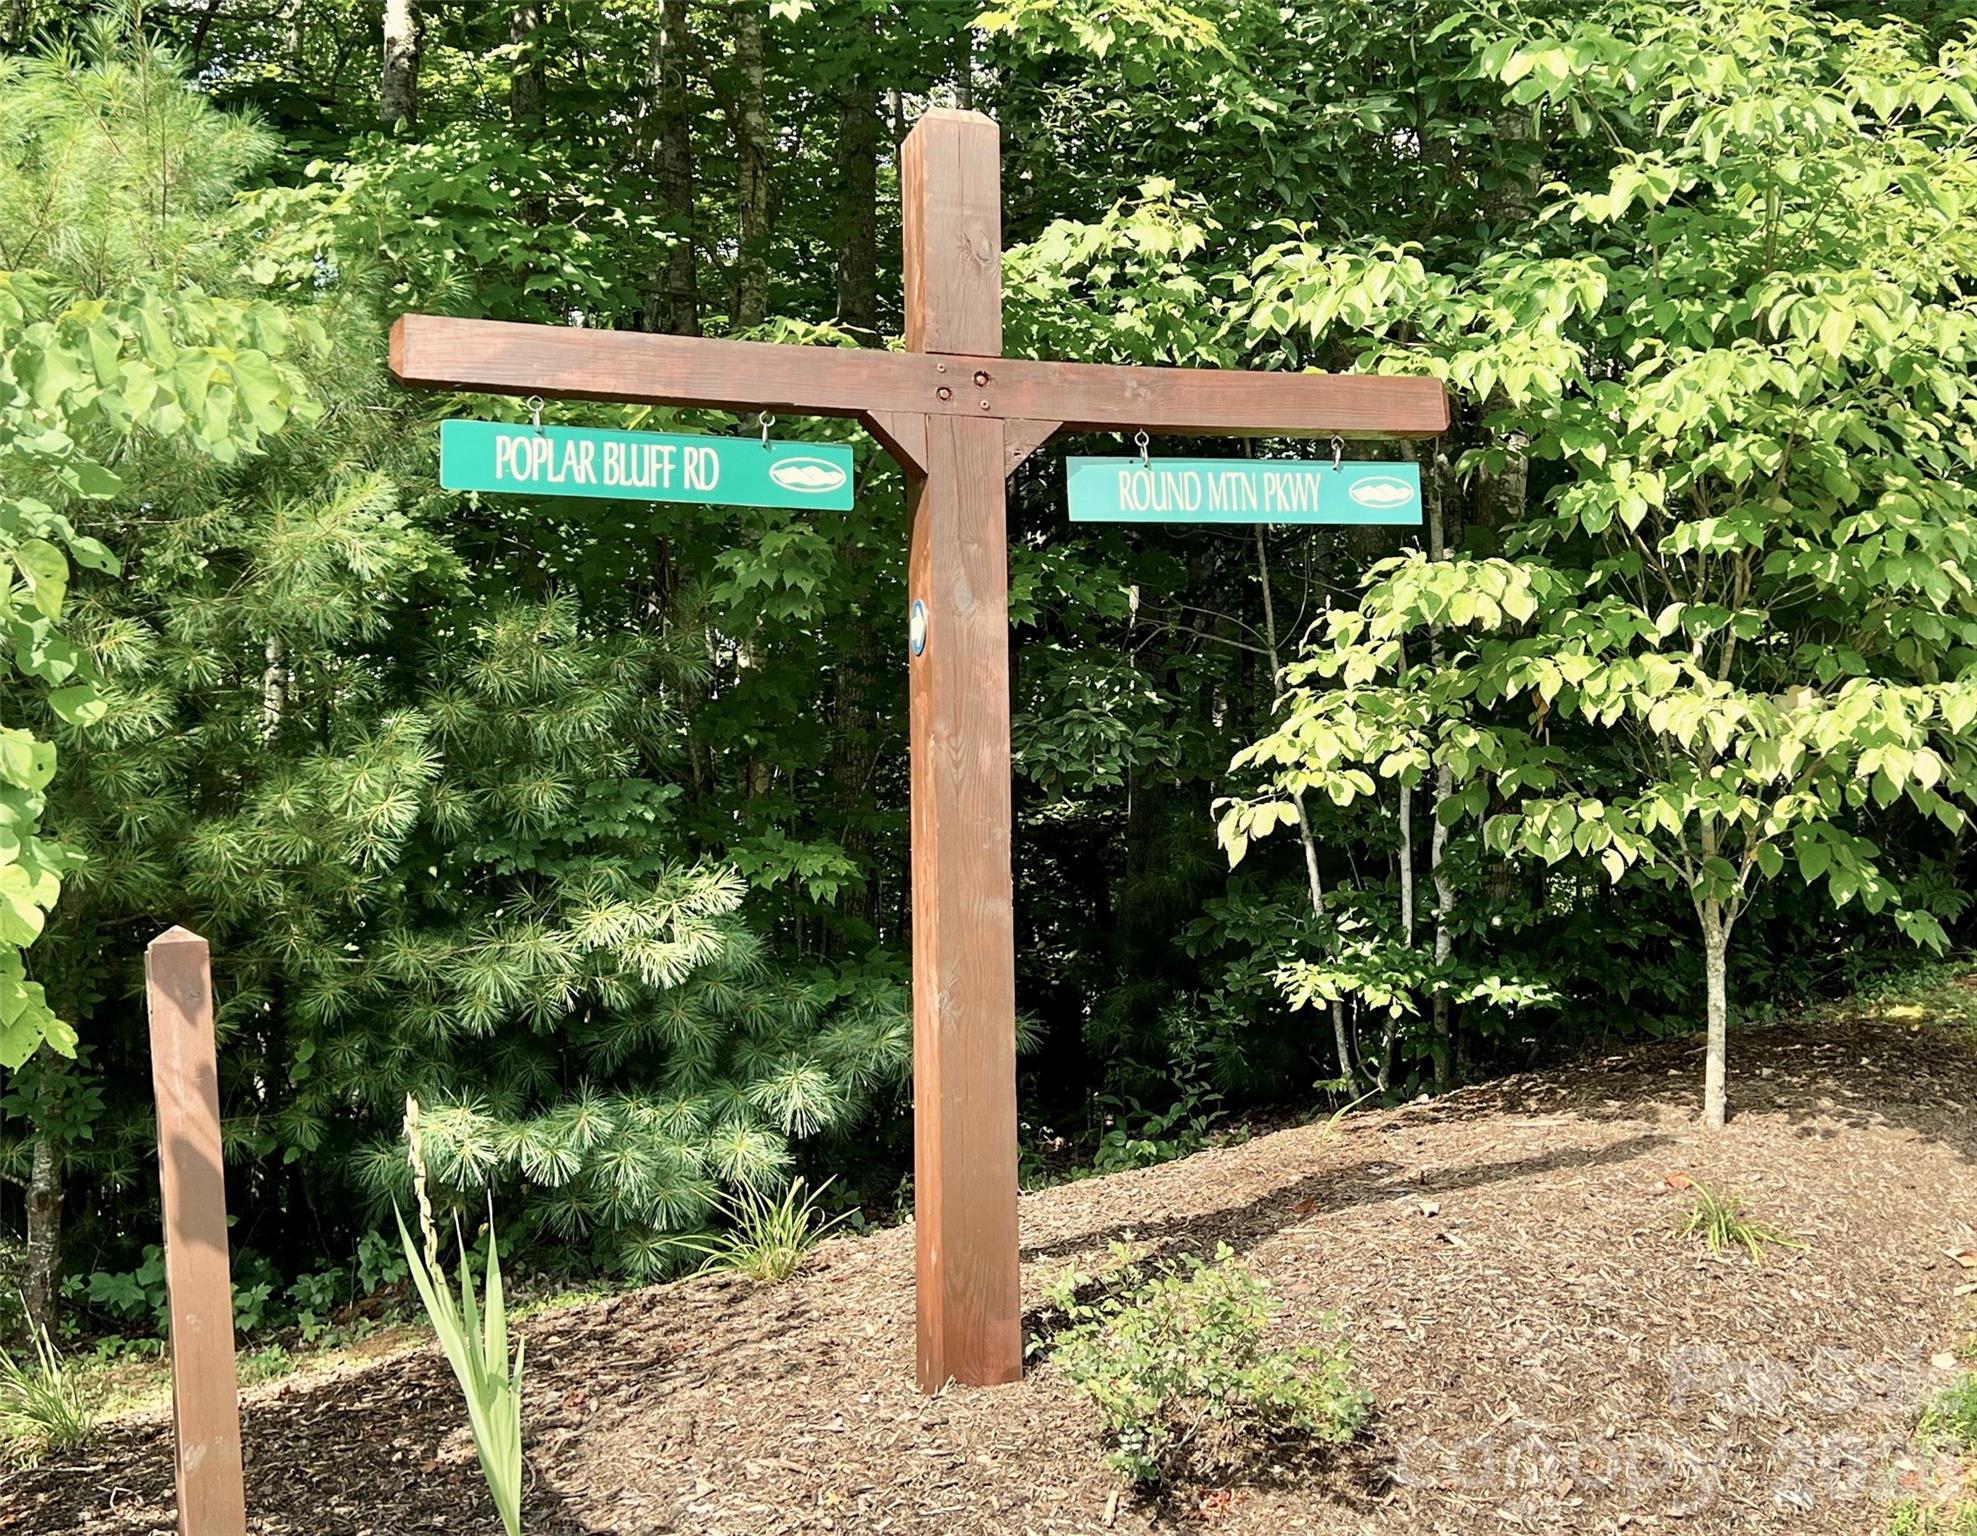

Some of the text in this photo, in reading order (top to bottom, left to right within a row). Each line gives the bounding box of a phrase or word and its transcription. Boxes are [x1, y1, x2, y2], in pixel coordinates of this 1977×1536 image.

[495, 435, 719, 490] POPLAR BLUFF RD
[1118, 471, 1321, 512] ROUND MTN PKWY
